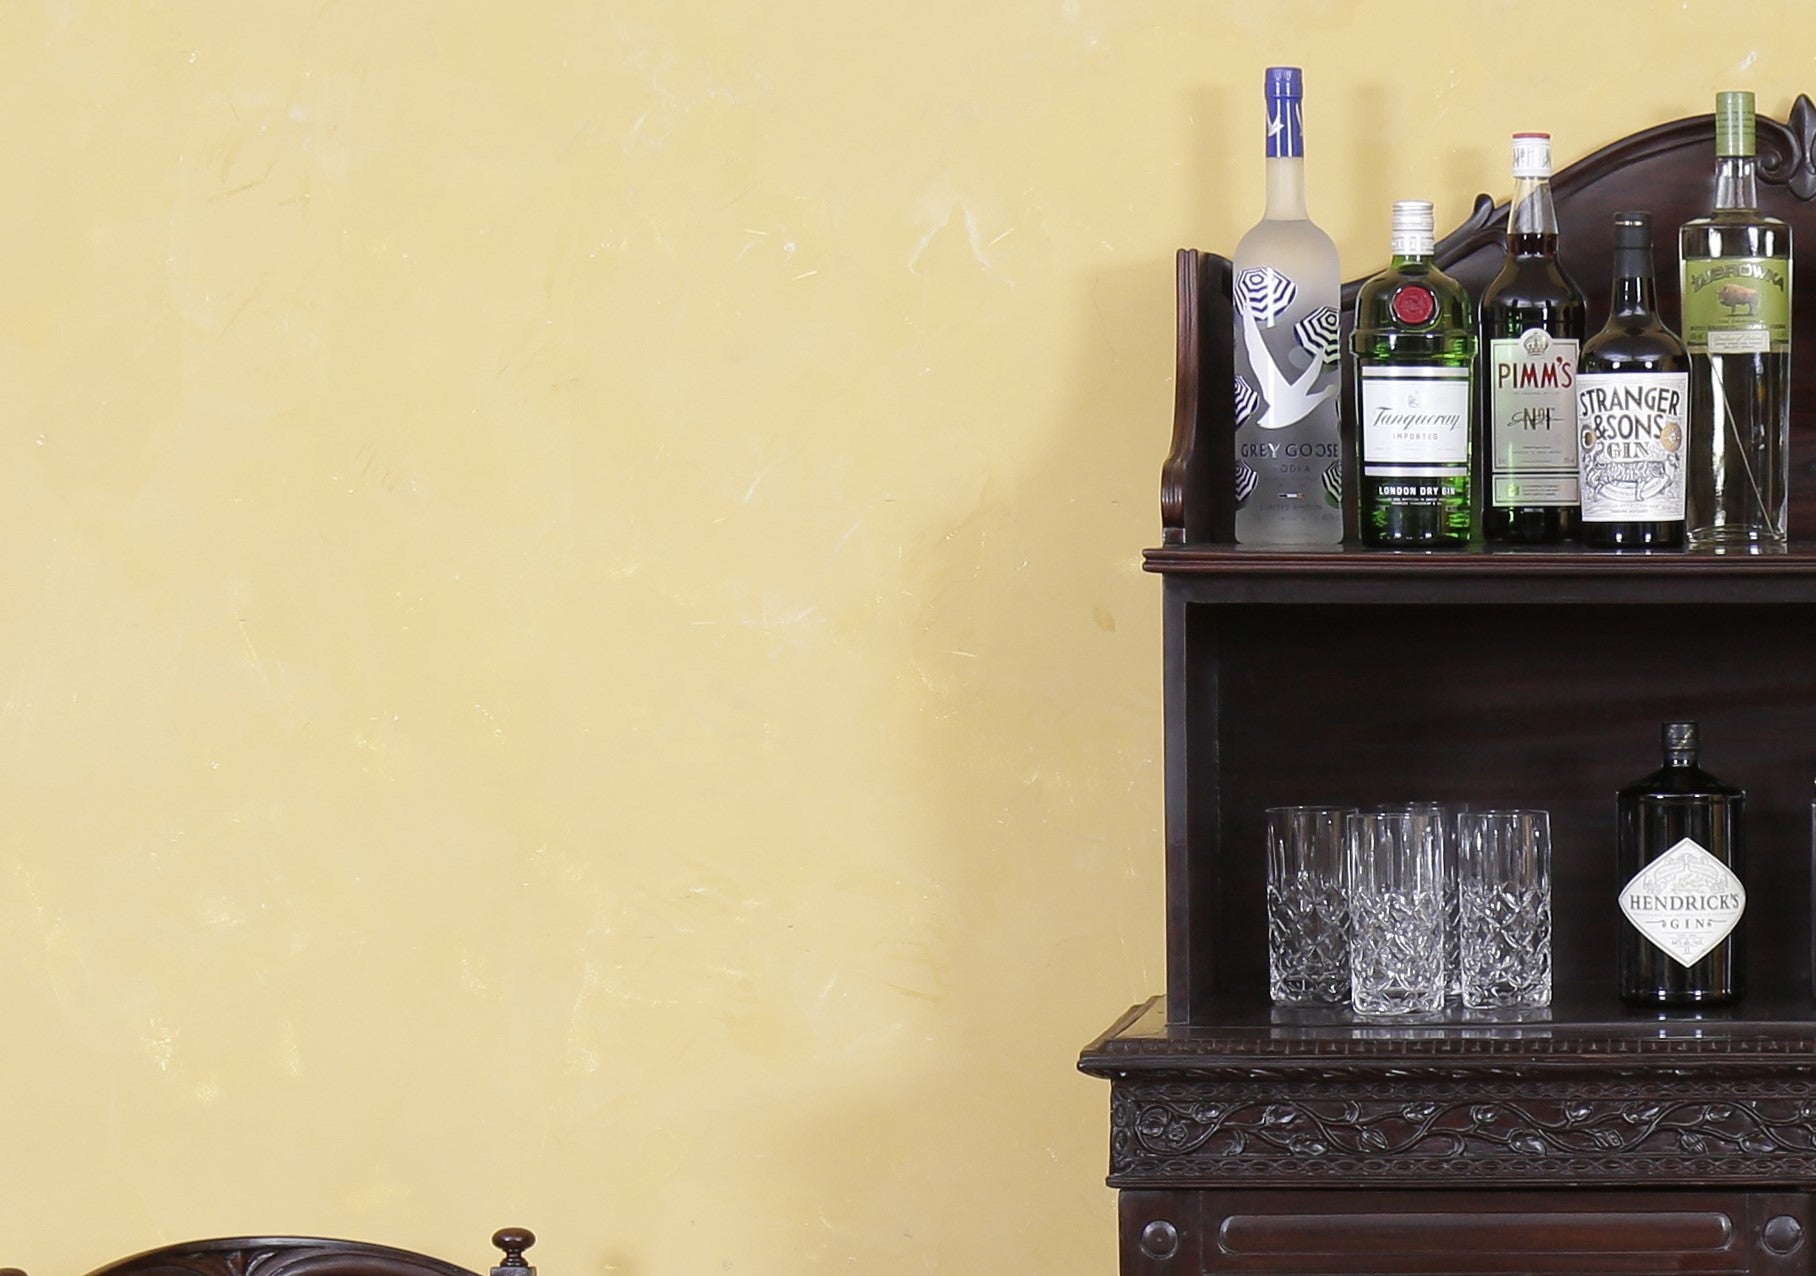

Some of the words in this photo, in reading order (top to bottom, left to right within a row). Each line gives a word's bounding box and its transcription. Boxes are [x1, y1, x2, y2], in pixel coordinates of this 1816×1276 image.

[1498, 356, 1572, 389] PIMM'S
[1580, 386, 1680, 417] STRANGER
[1373, 406, 1461, 431] Tanqueray
[1240, 443, 1280, 458] GREY
[1285, 443, 1339, 458] GOOSE
[1606, 442, 1651, 459] GIN
[1379, 486, 1417, 495] LONDON
[1420, 486, 1439, 495] DRY
[1442, 486, 1456, 495] GIN
[1630, 893, 1740, 911] HENDRICK'S
[1670, 919, 1705, 929] GIN
